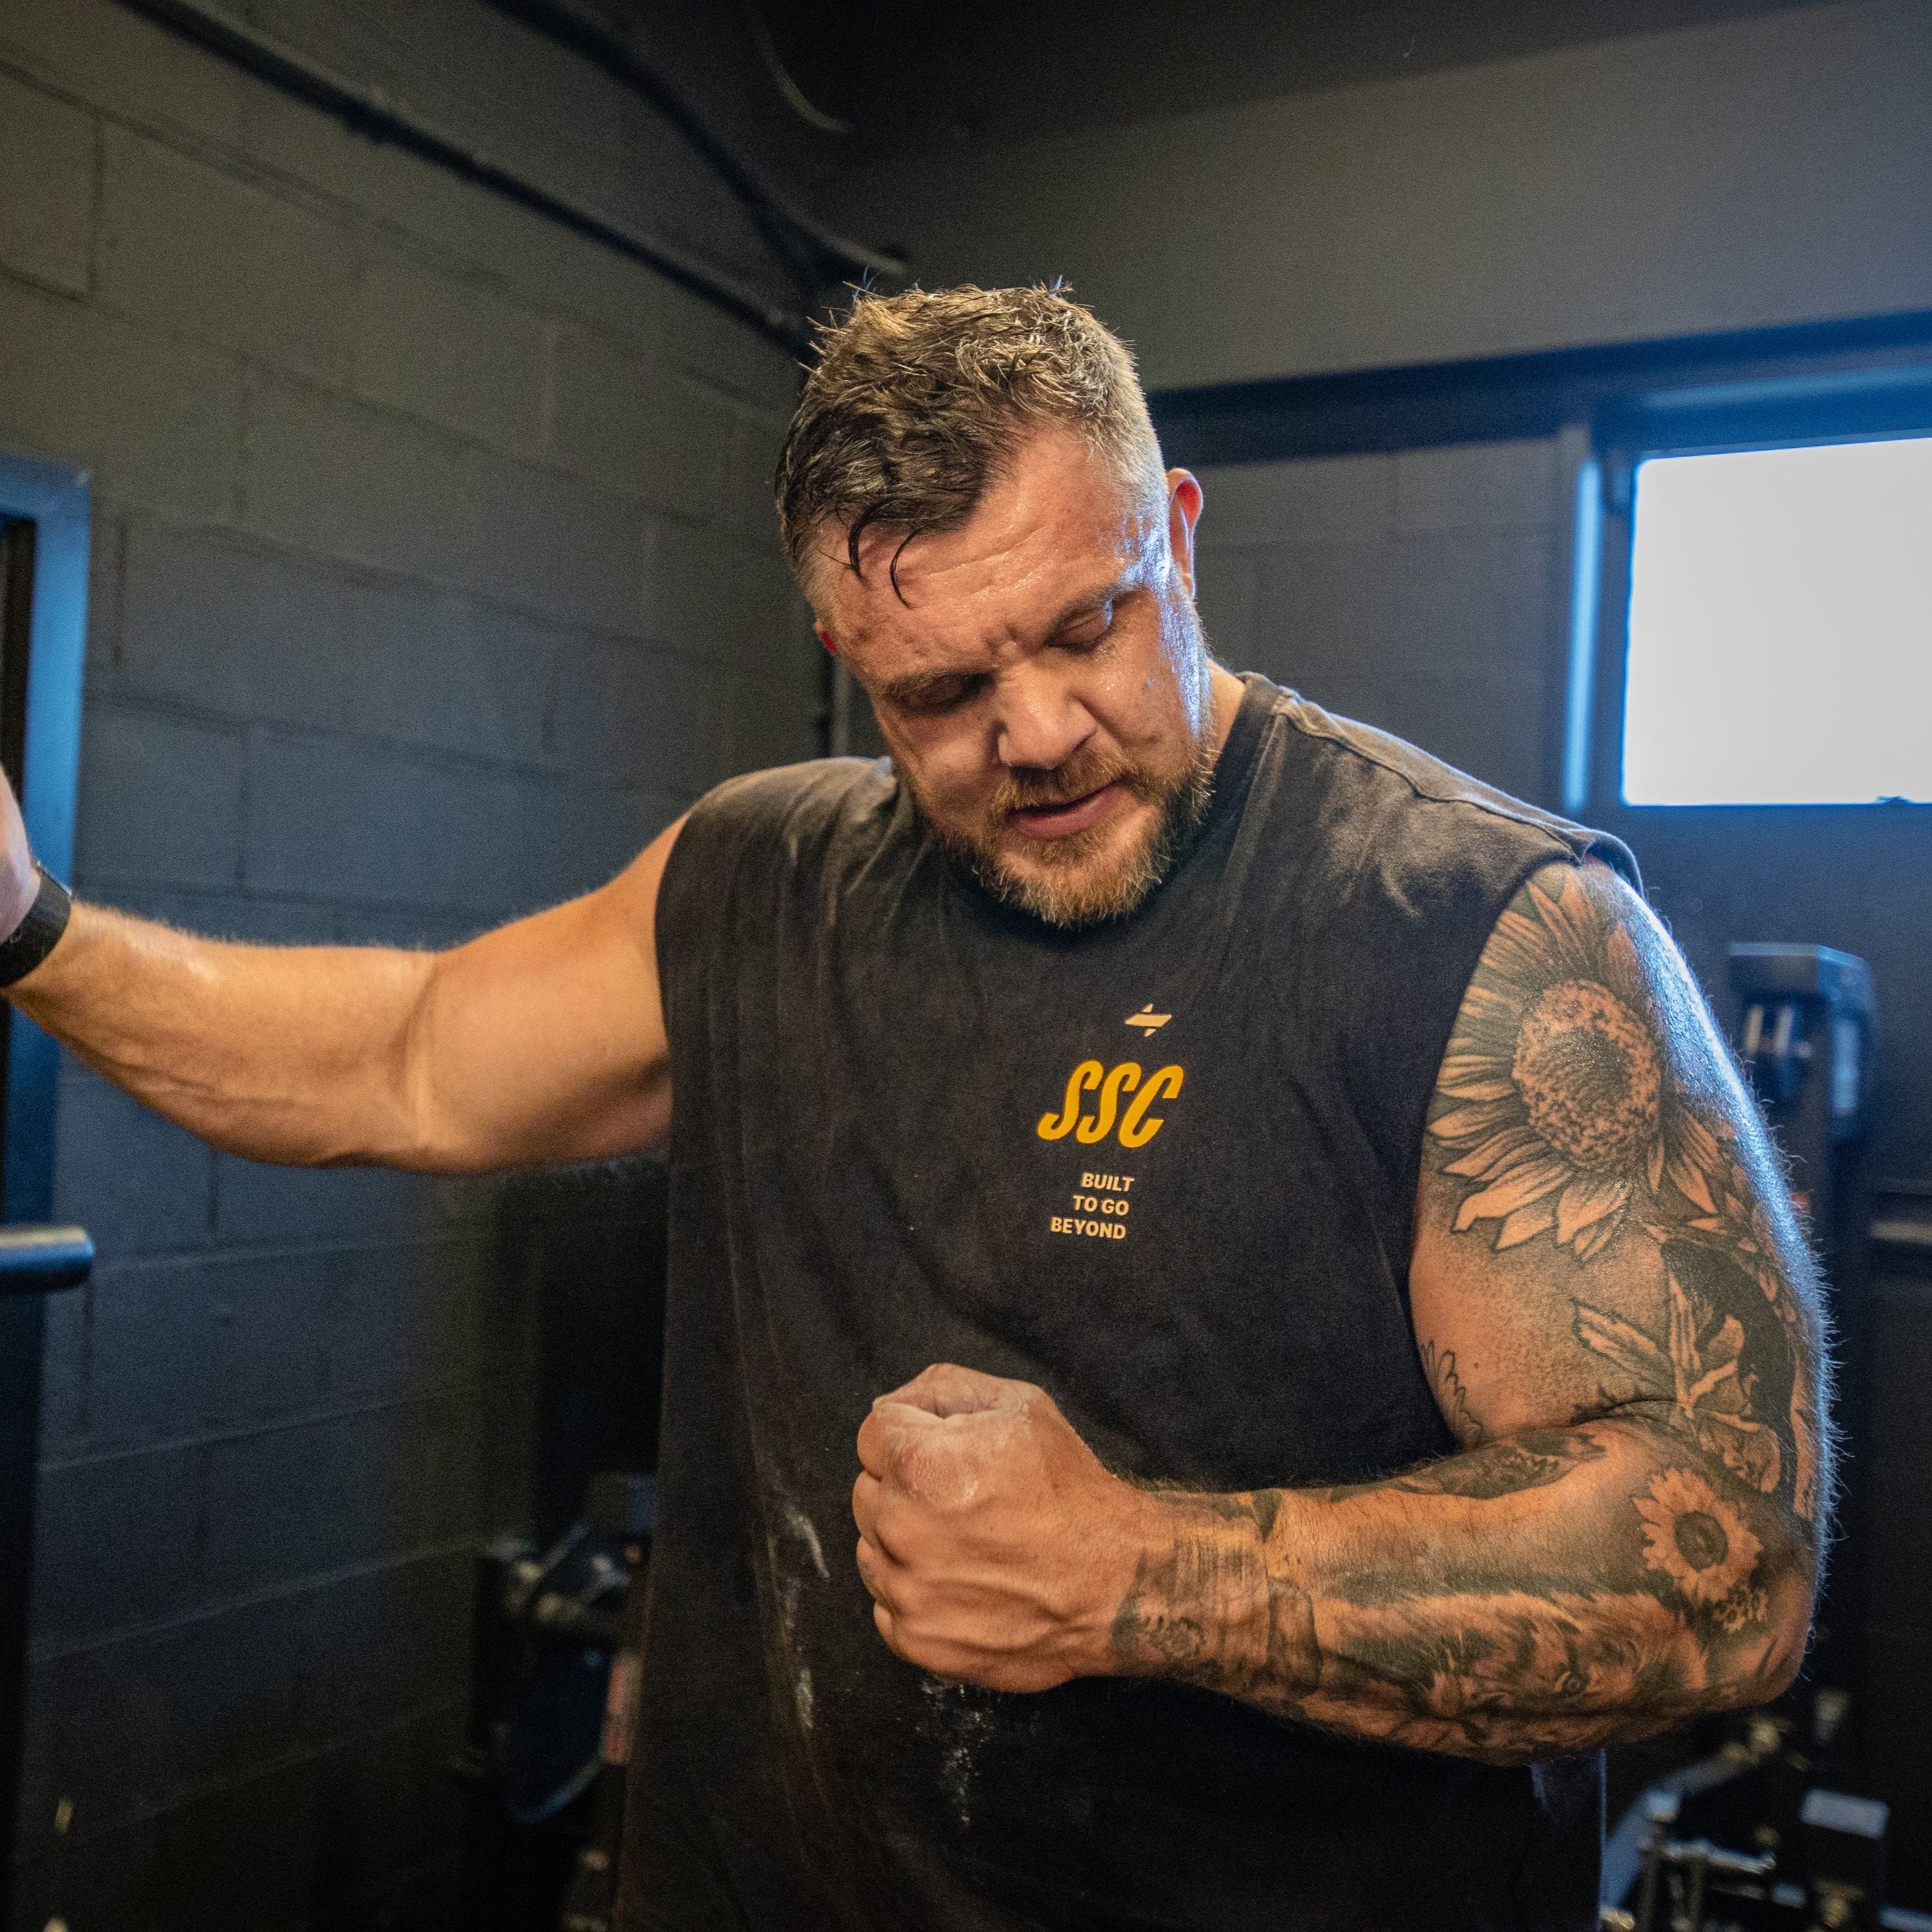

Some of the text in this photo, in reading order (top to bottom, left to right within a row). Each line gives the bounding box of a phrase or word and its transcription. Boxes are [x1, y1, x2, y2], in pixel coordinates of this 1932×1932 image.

[1037, 1059, 1184, 1148] SSC
[1081, 1172, 1134, 1191] BUILT
[1073, 1194, 1129, 1216] TO GO
[1050, 1216, 1126, 1240] BEYOND
